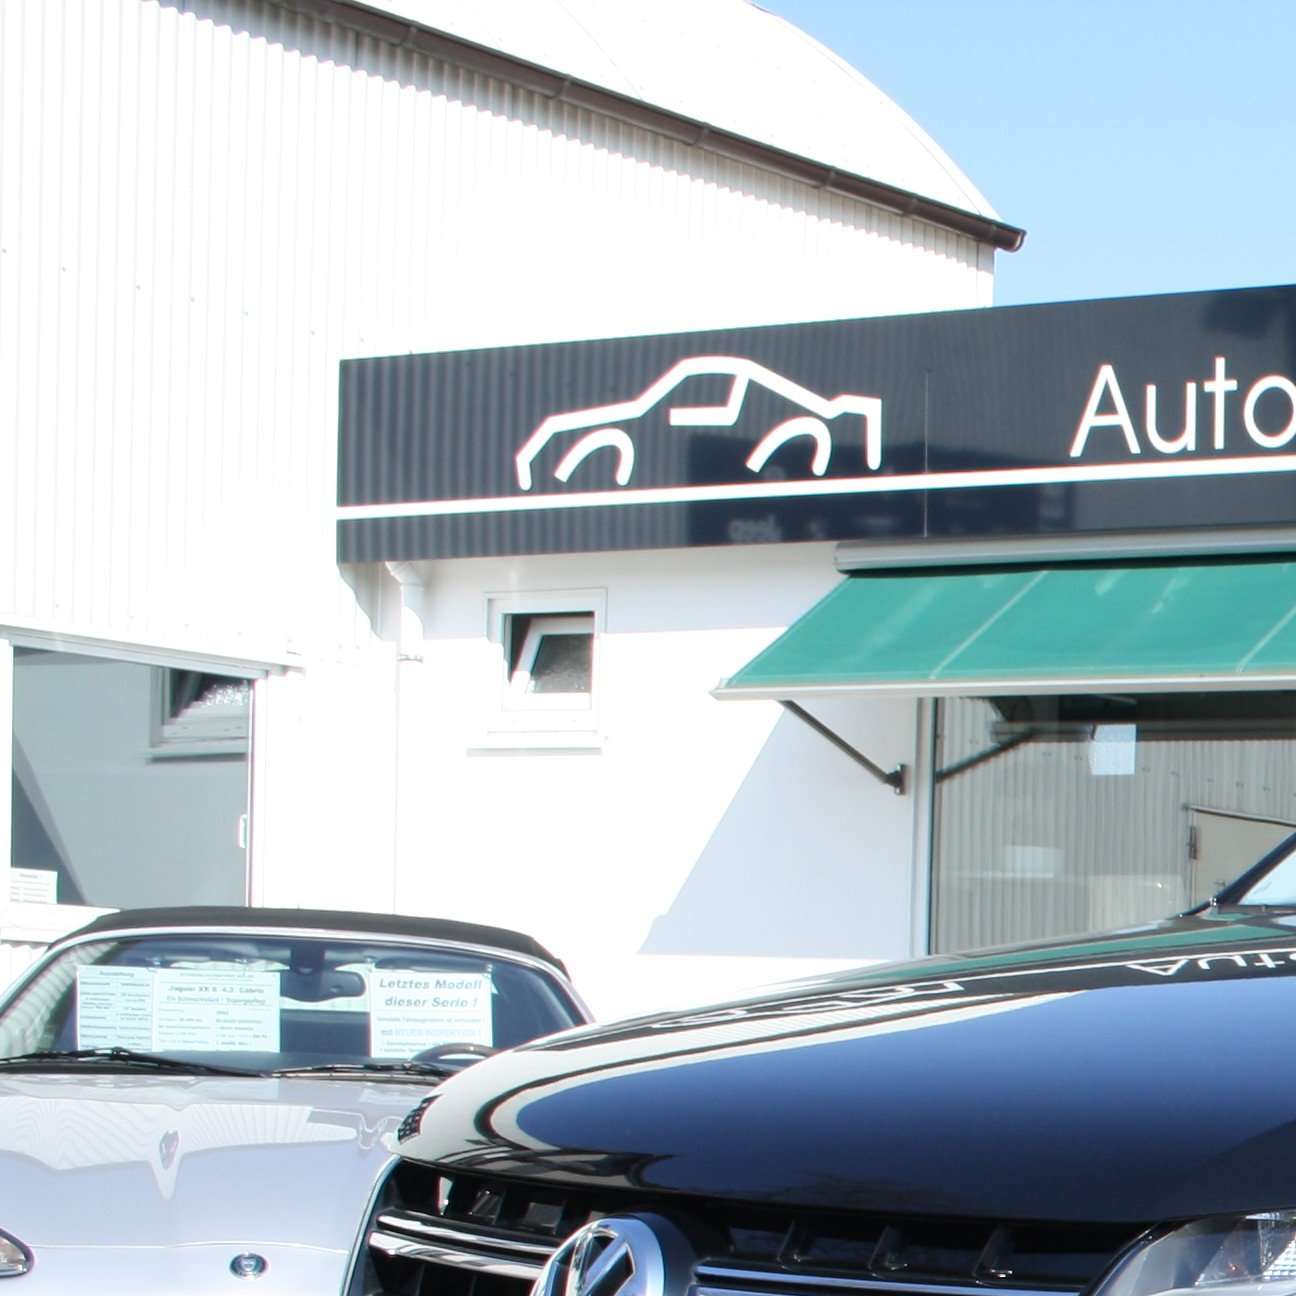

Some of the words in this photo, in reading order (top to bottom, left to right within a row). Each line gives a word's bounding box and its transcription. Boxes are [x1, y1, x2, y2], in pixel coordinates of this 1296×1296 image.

[379, 978, 430, 990] Letztes
[435, 979, 482, 990] Modell
[384, 996, 427, 1008] dieser
[431, 996, 468, 1008] Serie
